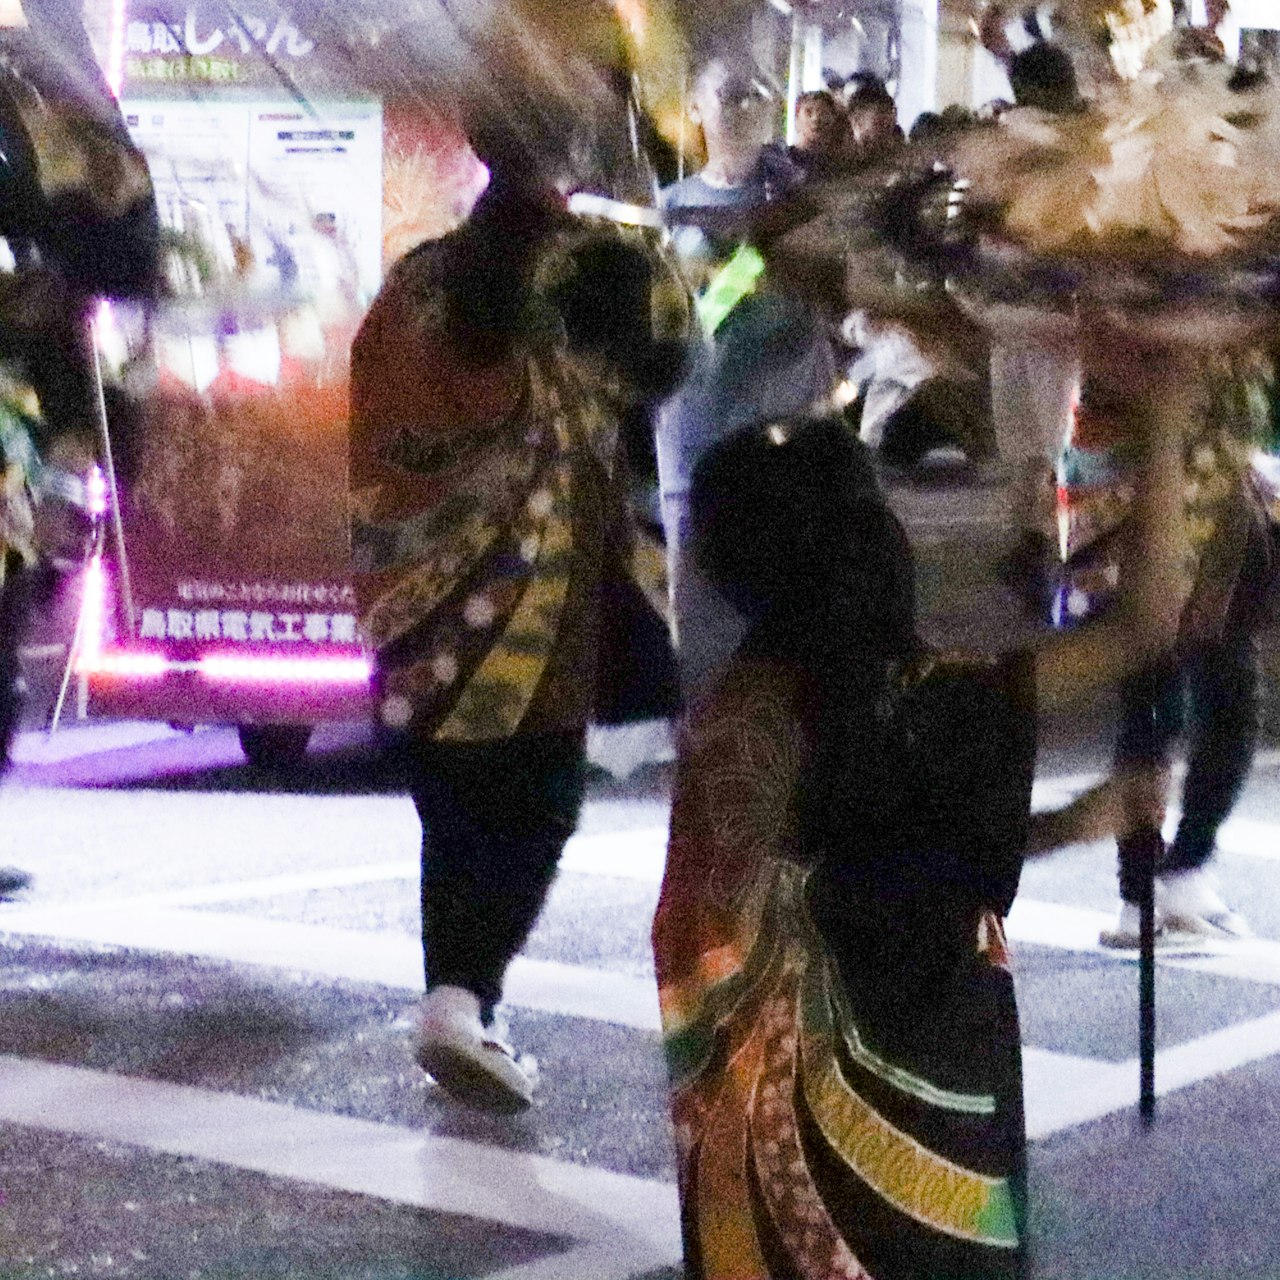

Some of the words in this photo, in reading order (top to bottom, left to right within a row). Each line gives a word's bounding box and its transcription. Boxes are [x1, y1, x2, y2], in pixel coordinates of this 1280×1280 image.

[140, 609, 363, 642] 鳥取県電気工事業
